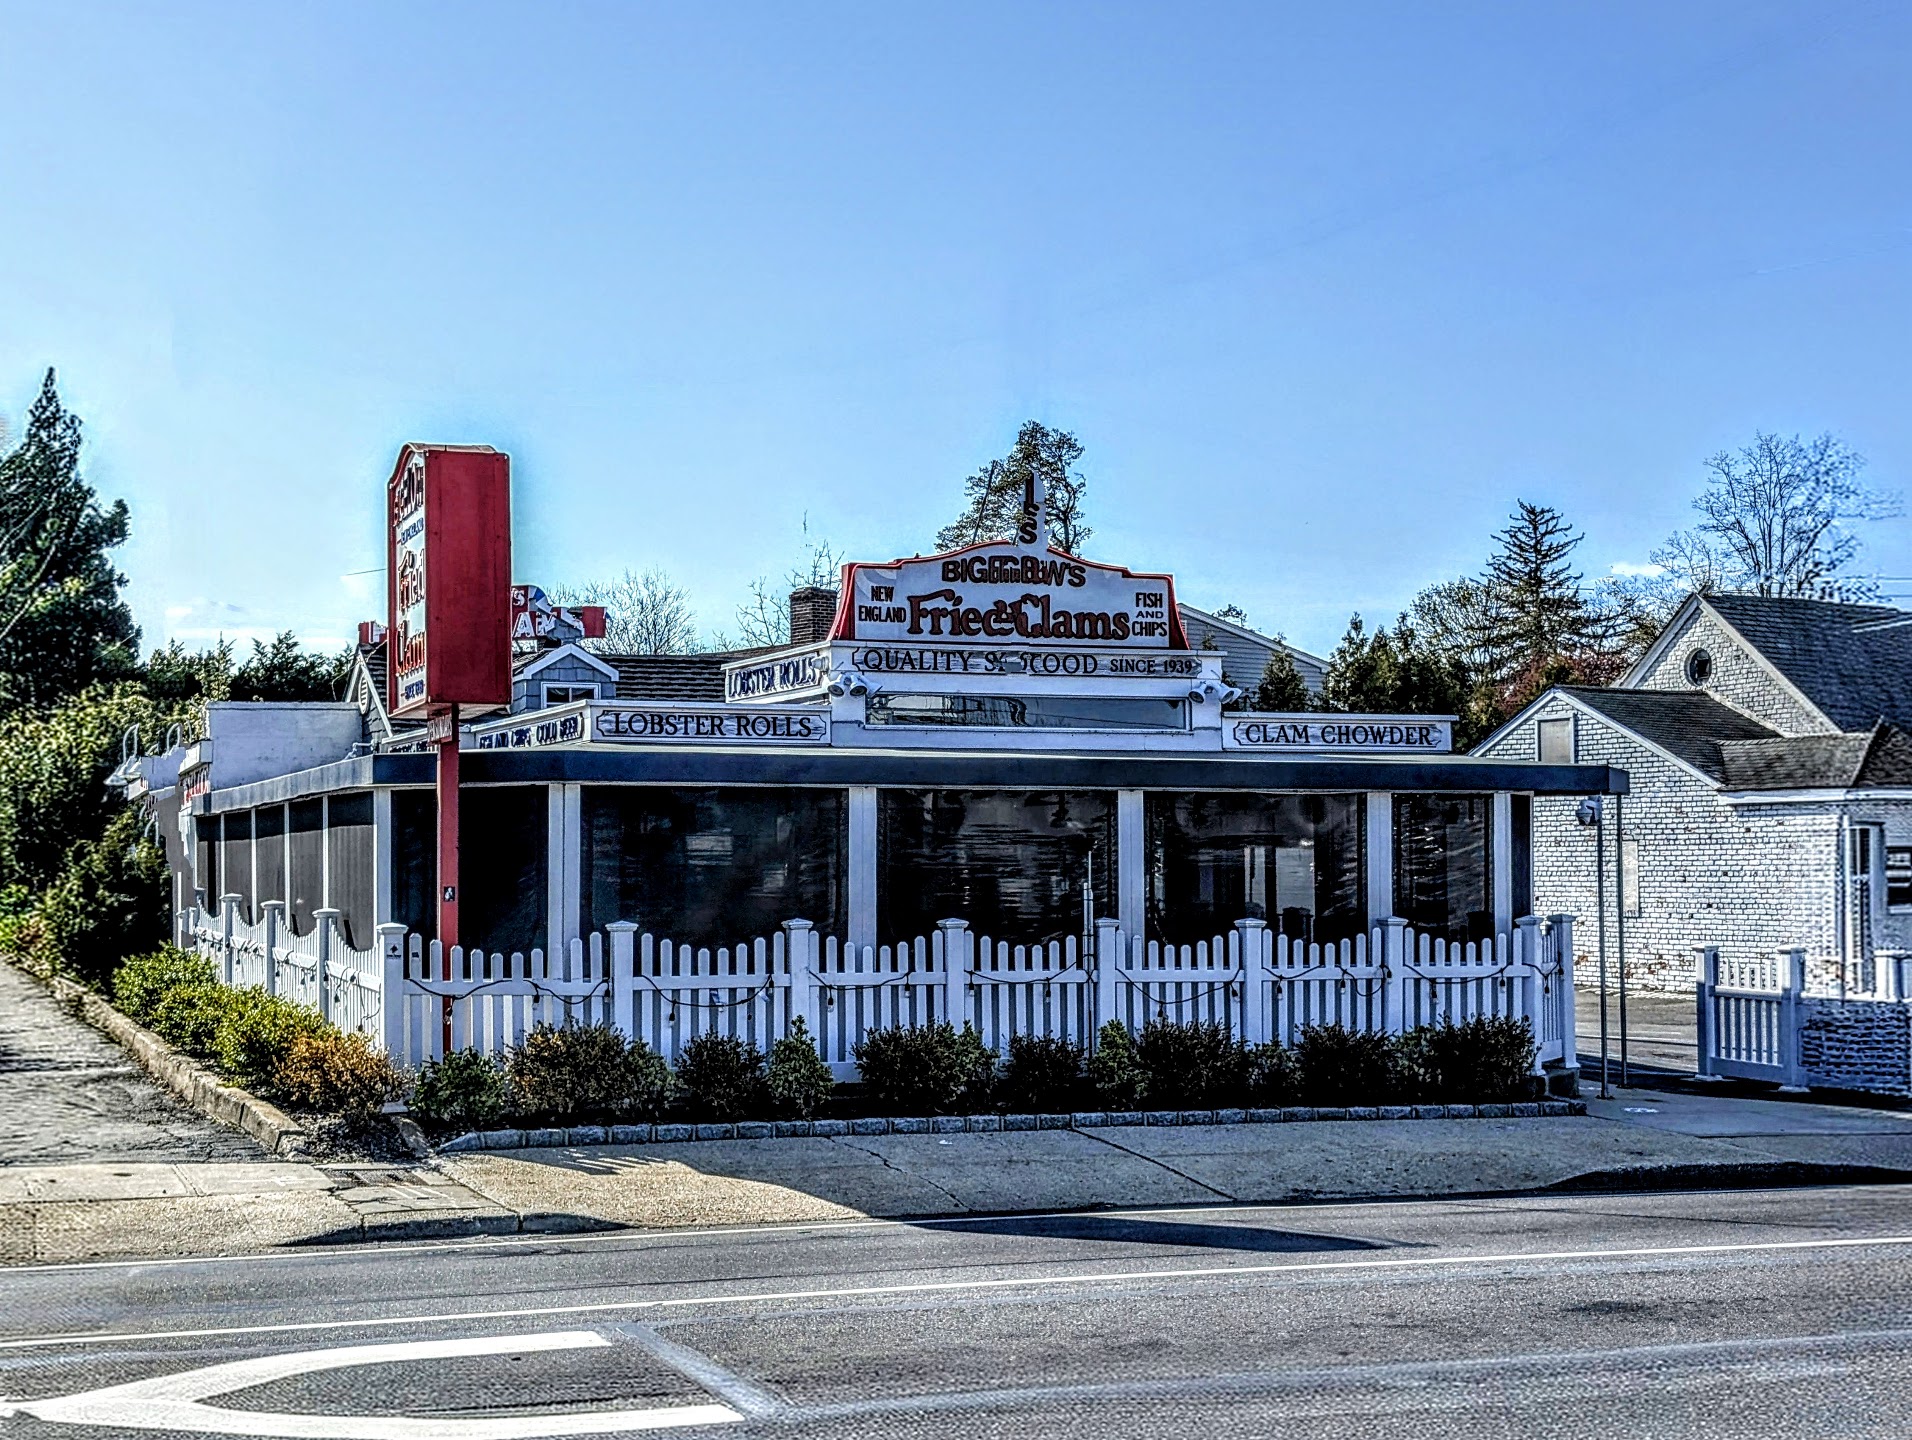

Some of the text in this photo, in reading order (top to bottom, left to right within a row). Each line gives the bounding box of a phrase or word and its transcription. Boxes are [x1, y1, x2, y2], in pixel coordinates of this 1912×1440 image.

[870, 586, 895, 602] NEW
[1135, 592, 1163, 609] FISH
[858, 605, 907, 624] ENGLAND
[1135, 610, 1164, 619] AND
[1131, 620, 1168, 638] CHIPS
[863, 649, 974, 672] QUALITY
[1110, 658, 1156, 673] SINCE
[1162, 659, 1193, 674] 1939
[614, 712, 812, 738] LOBSTER ROLLS
[1245, 724, 1432, 746] CLAM CHOWDER
